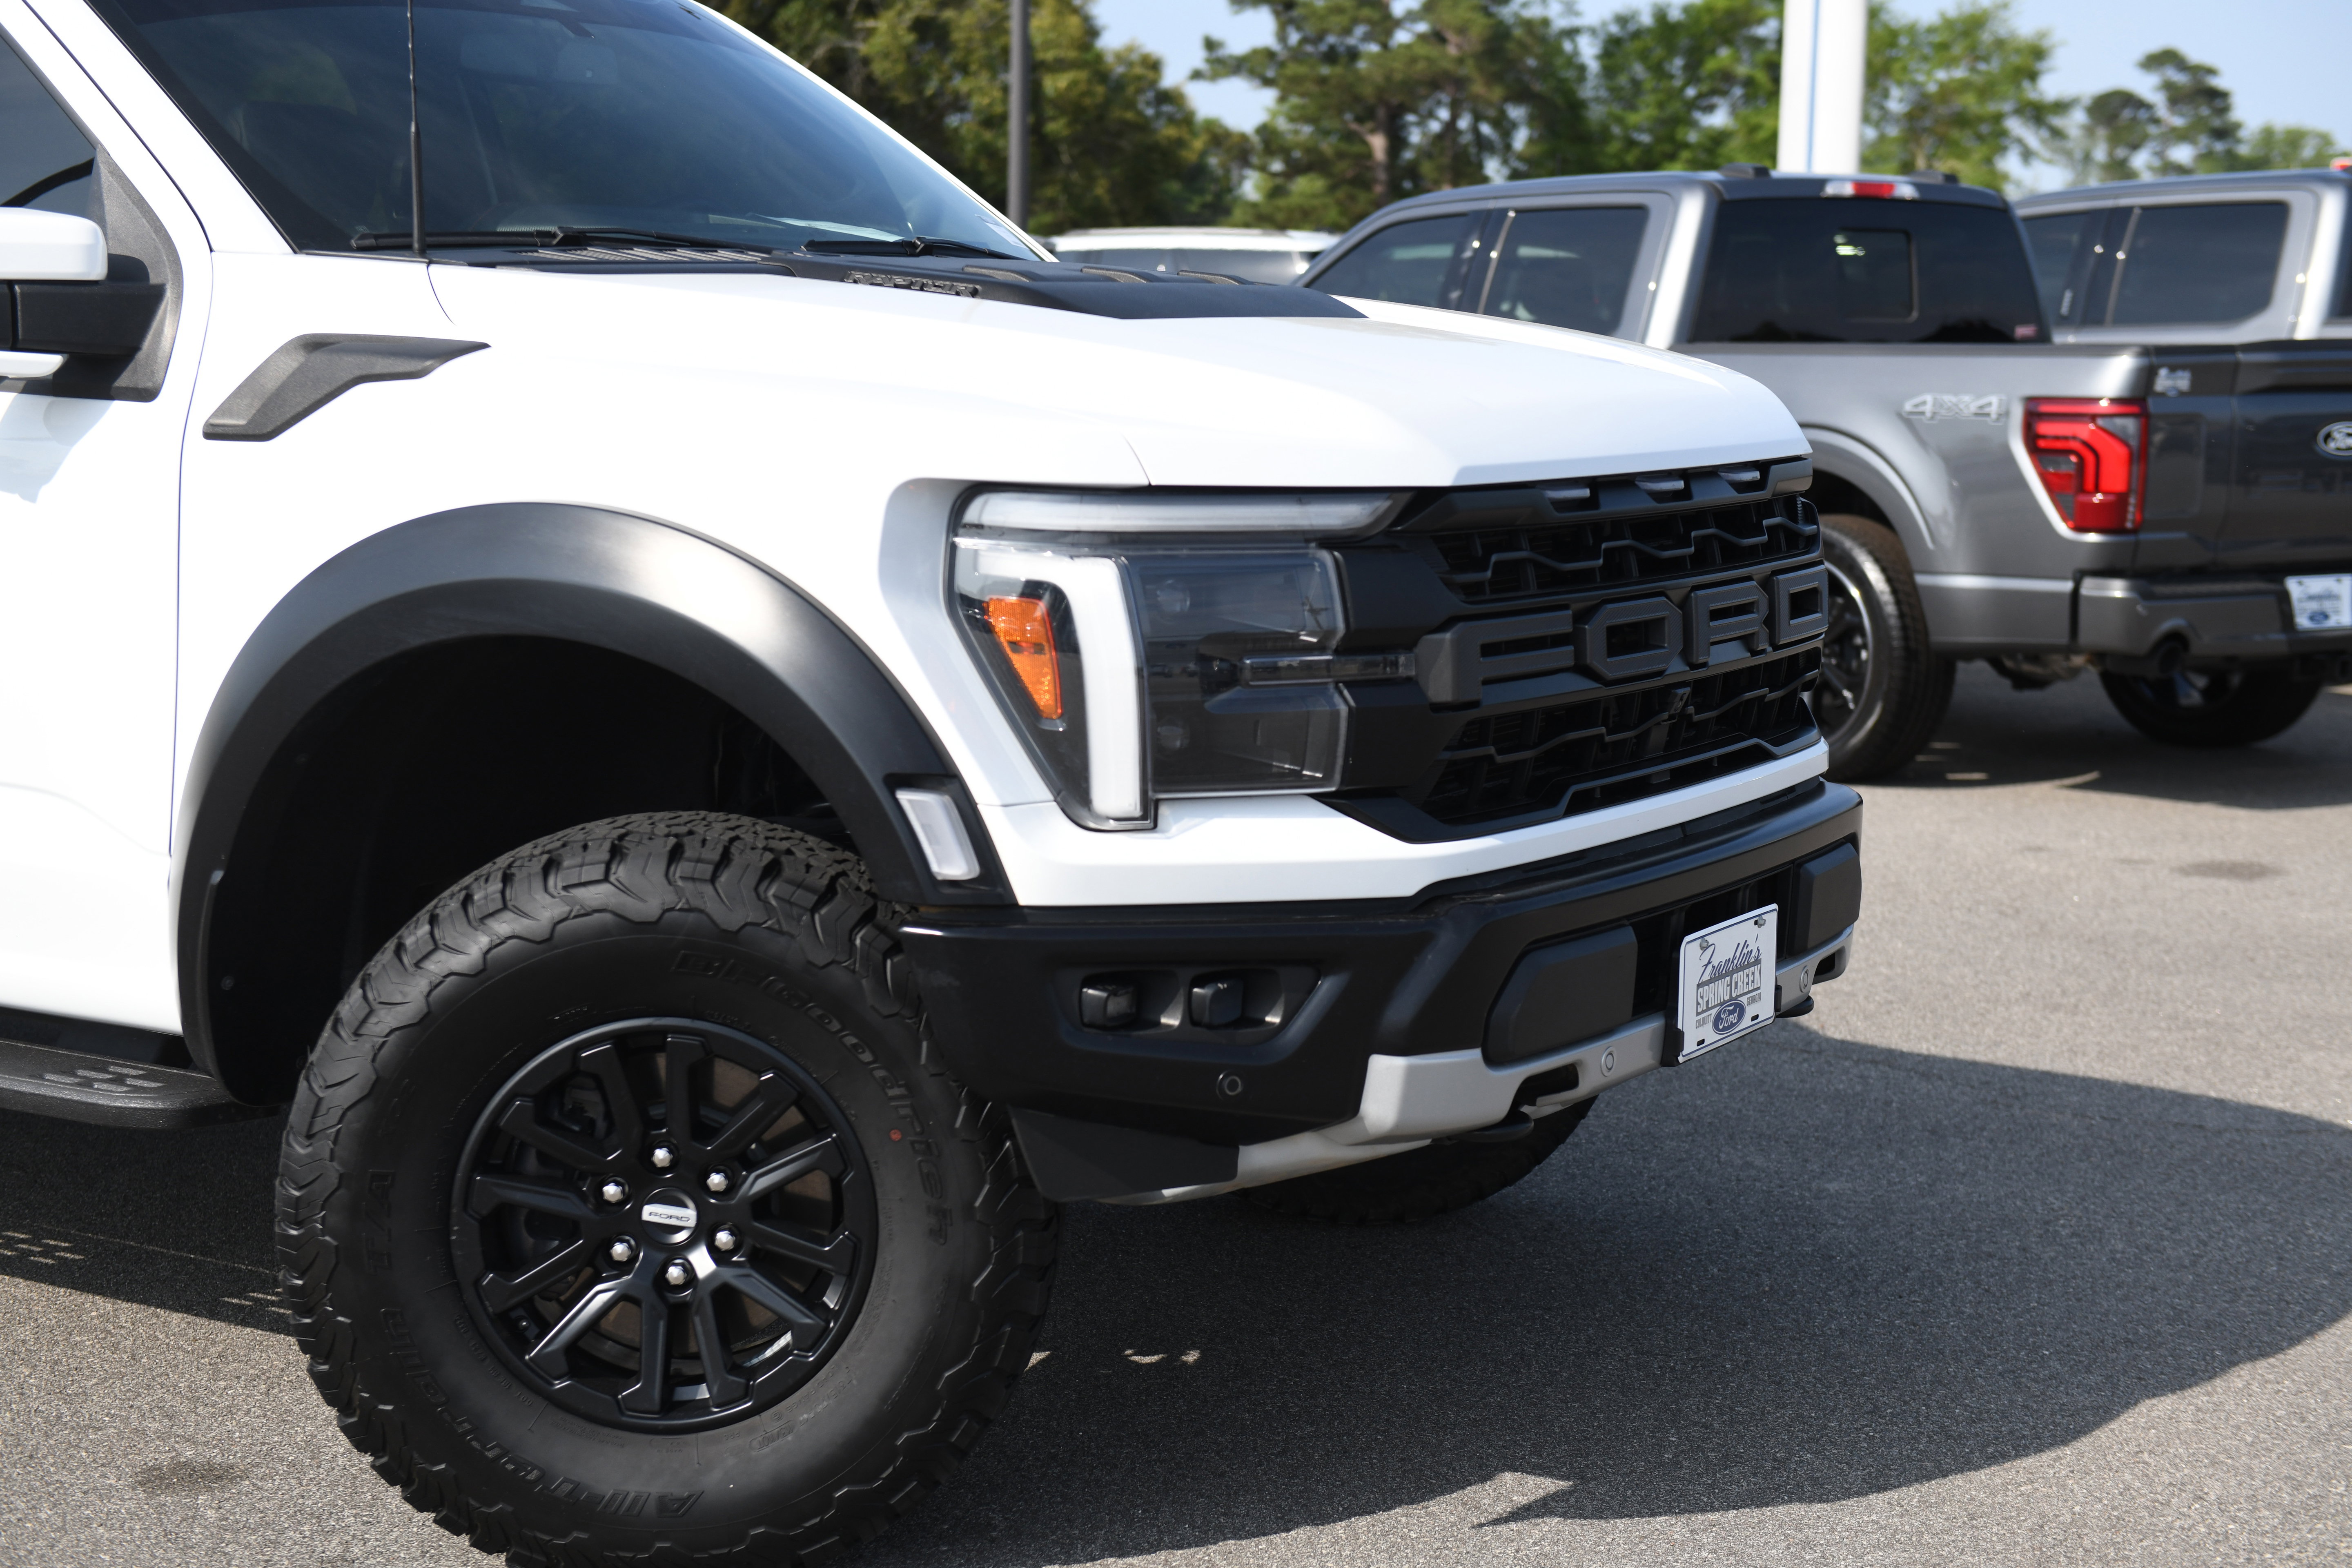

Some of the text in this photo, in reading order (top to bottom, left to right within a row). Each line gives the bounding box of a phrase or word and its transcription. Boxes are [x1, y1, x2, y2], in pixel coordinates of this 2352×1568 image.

[844, 270, 980, 298] RAPTOR
[1420, 564, 1829, 702] FORD
[1698, 933, 1762, 984] Franklin's
[1697, 964, 1761, 1013] SPRING CREEK
[1746, 992, 1762, 1006] GEORGIA
[1695, 1013, 1712, 1029] COLQUITT
[1719, 1006, 1739, 1029] Ford
[648, 1211, 691, 1222] FORD
[380, 1308, 704, 1518] All-Terrain
